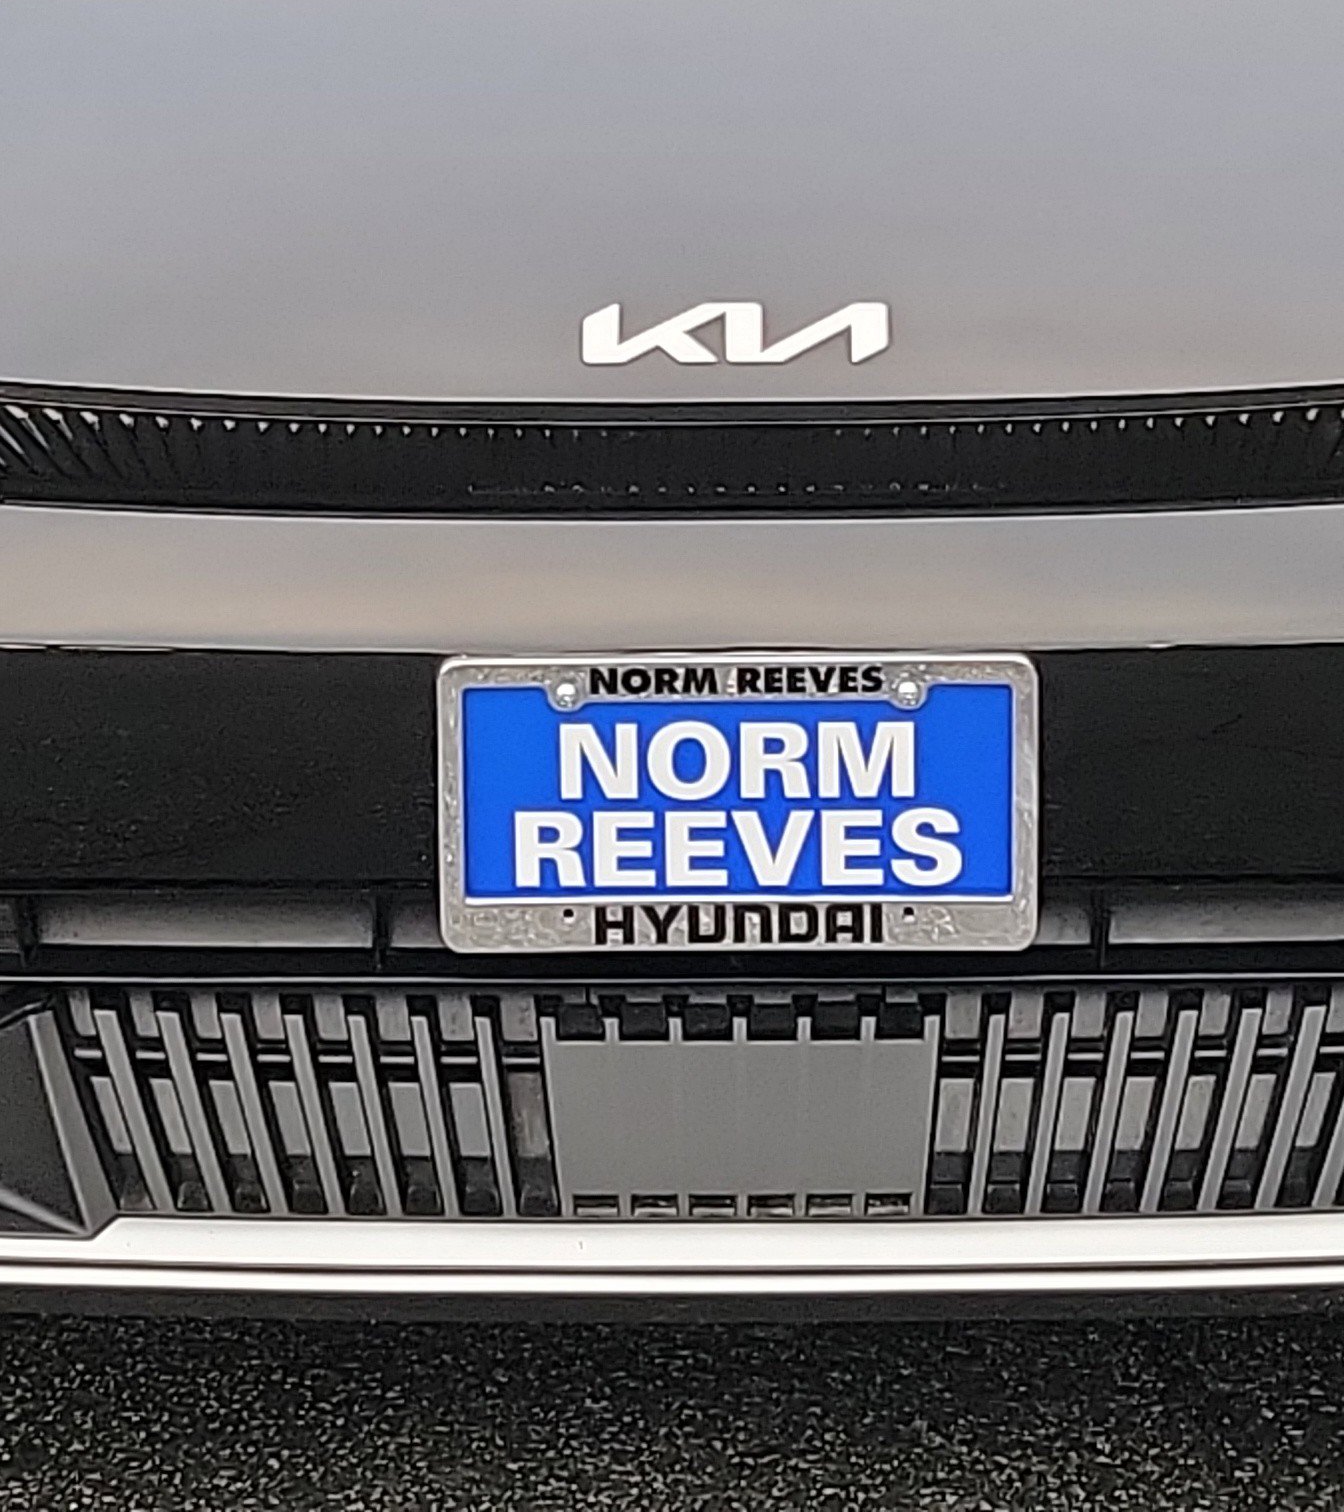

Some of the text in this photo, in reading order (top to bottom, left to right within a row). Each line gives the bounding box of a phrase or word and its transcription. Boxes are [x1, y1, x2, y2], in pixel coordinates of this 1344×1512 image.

[589, 666, 884, 694] NORM REEVES
[558, 721, 917, 801] NORM
[513, 808, 964, 888] REEVES
[594, 905, 884, 944] HYUNDAI
